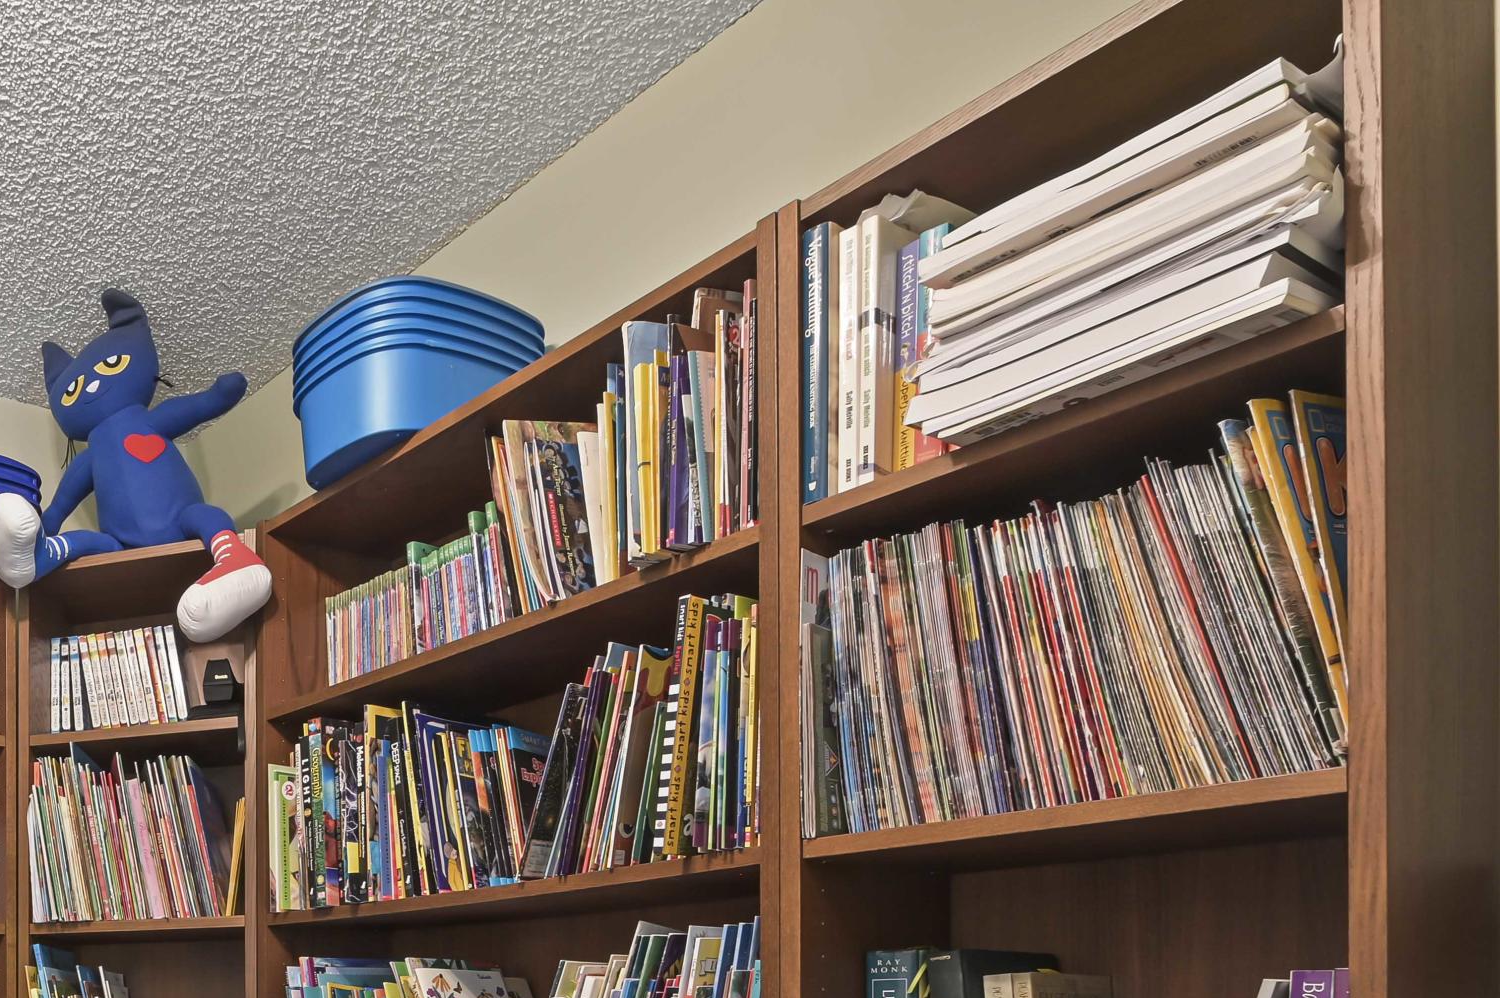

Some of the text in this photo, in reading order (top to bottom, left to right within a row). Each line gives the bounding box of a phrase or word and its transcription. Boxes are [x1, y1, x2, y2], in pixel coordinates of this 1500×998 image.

[804, 235, 822, 281] Vogue
[844, 390, 853, 430] Sally Melville
[551, 462, 564, 497] Ann Turner
[548, 500, 561, 547] SCHOLASTIC
[681, 600, 699, 675] smart kids
[675, 689, 690, 761] smart kids
[301, 758, 311, 804] LIGHT
[308, 746, 324, 800] Geography
[355, 745, 364, 786] Molecules
[390, 741, 402, 785] DEEP SPACE
[664, 775, 682, 846] smart kids
[870, 966, 908, 974] MONK
